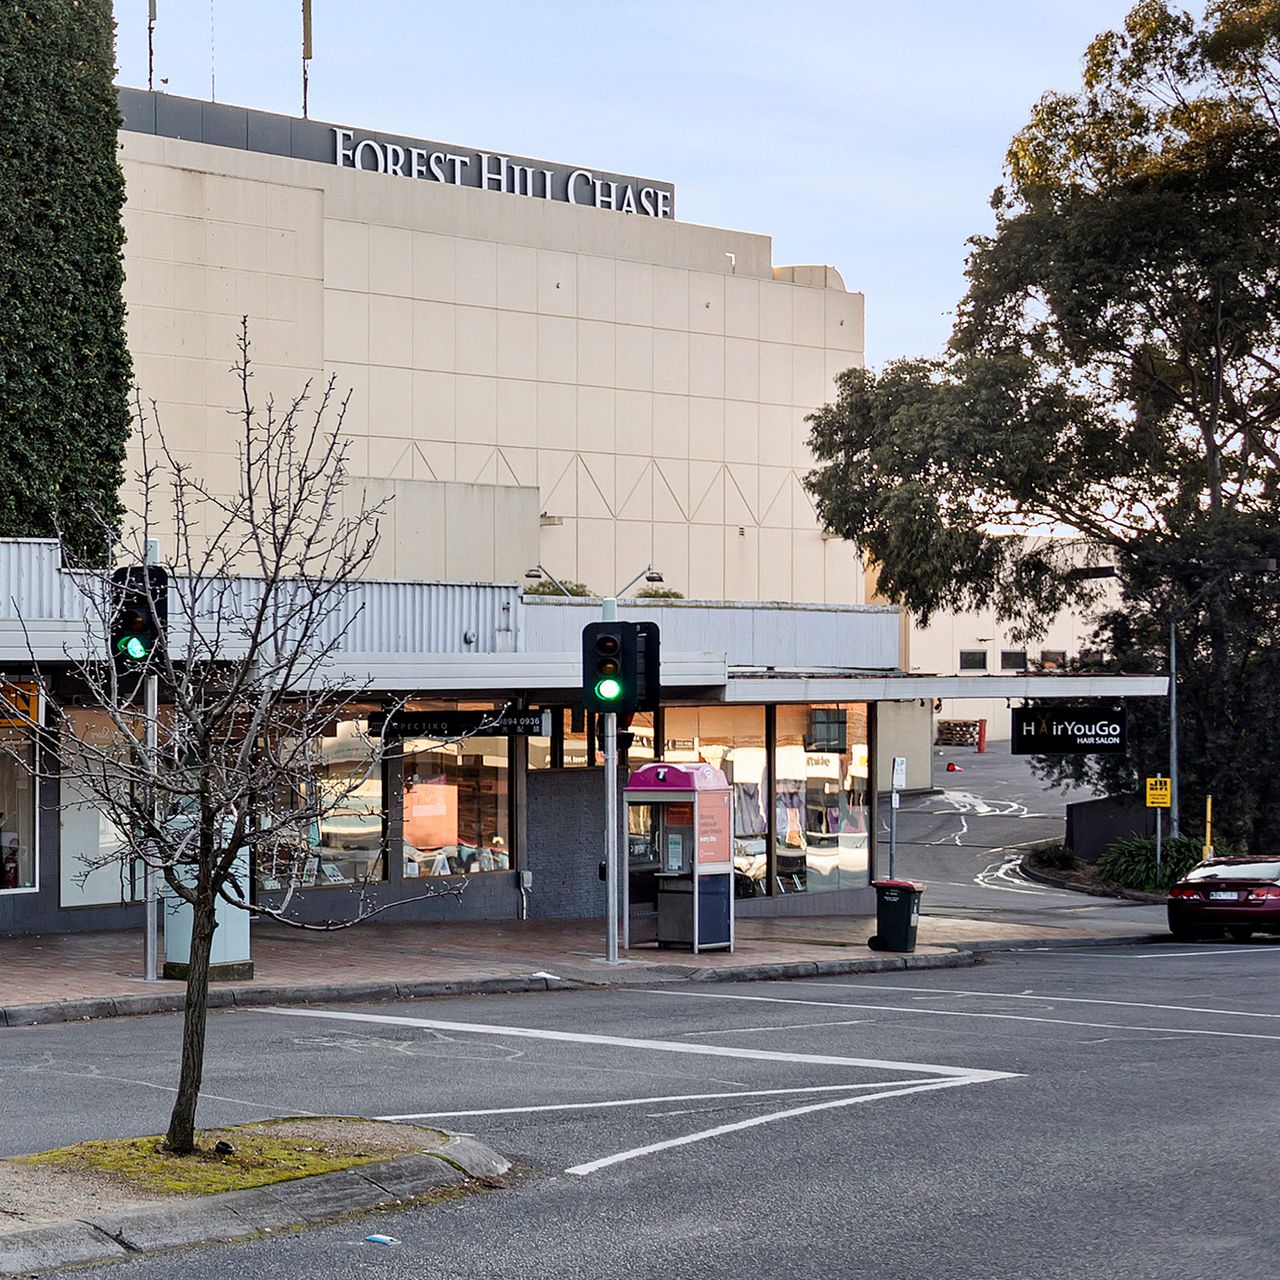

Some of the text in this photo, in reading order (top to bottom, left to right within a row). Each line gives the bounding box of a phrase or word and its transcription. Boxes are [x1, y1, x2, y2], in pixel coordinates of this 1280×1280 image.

[331, 127, 671, 219] FOREST HILL CHASE
